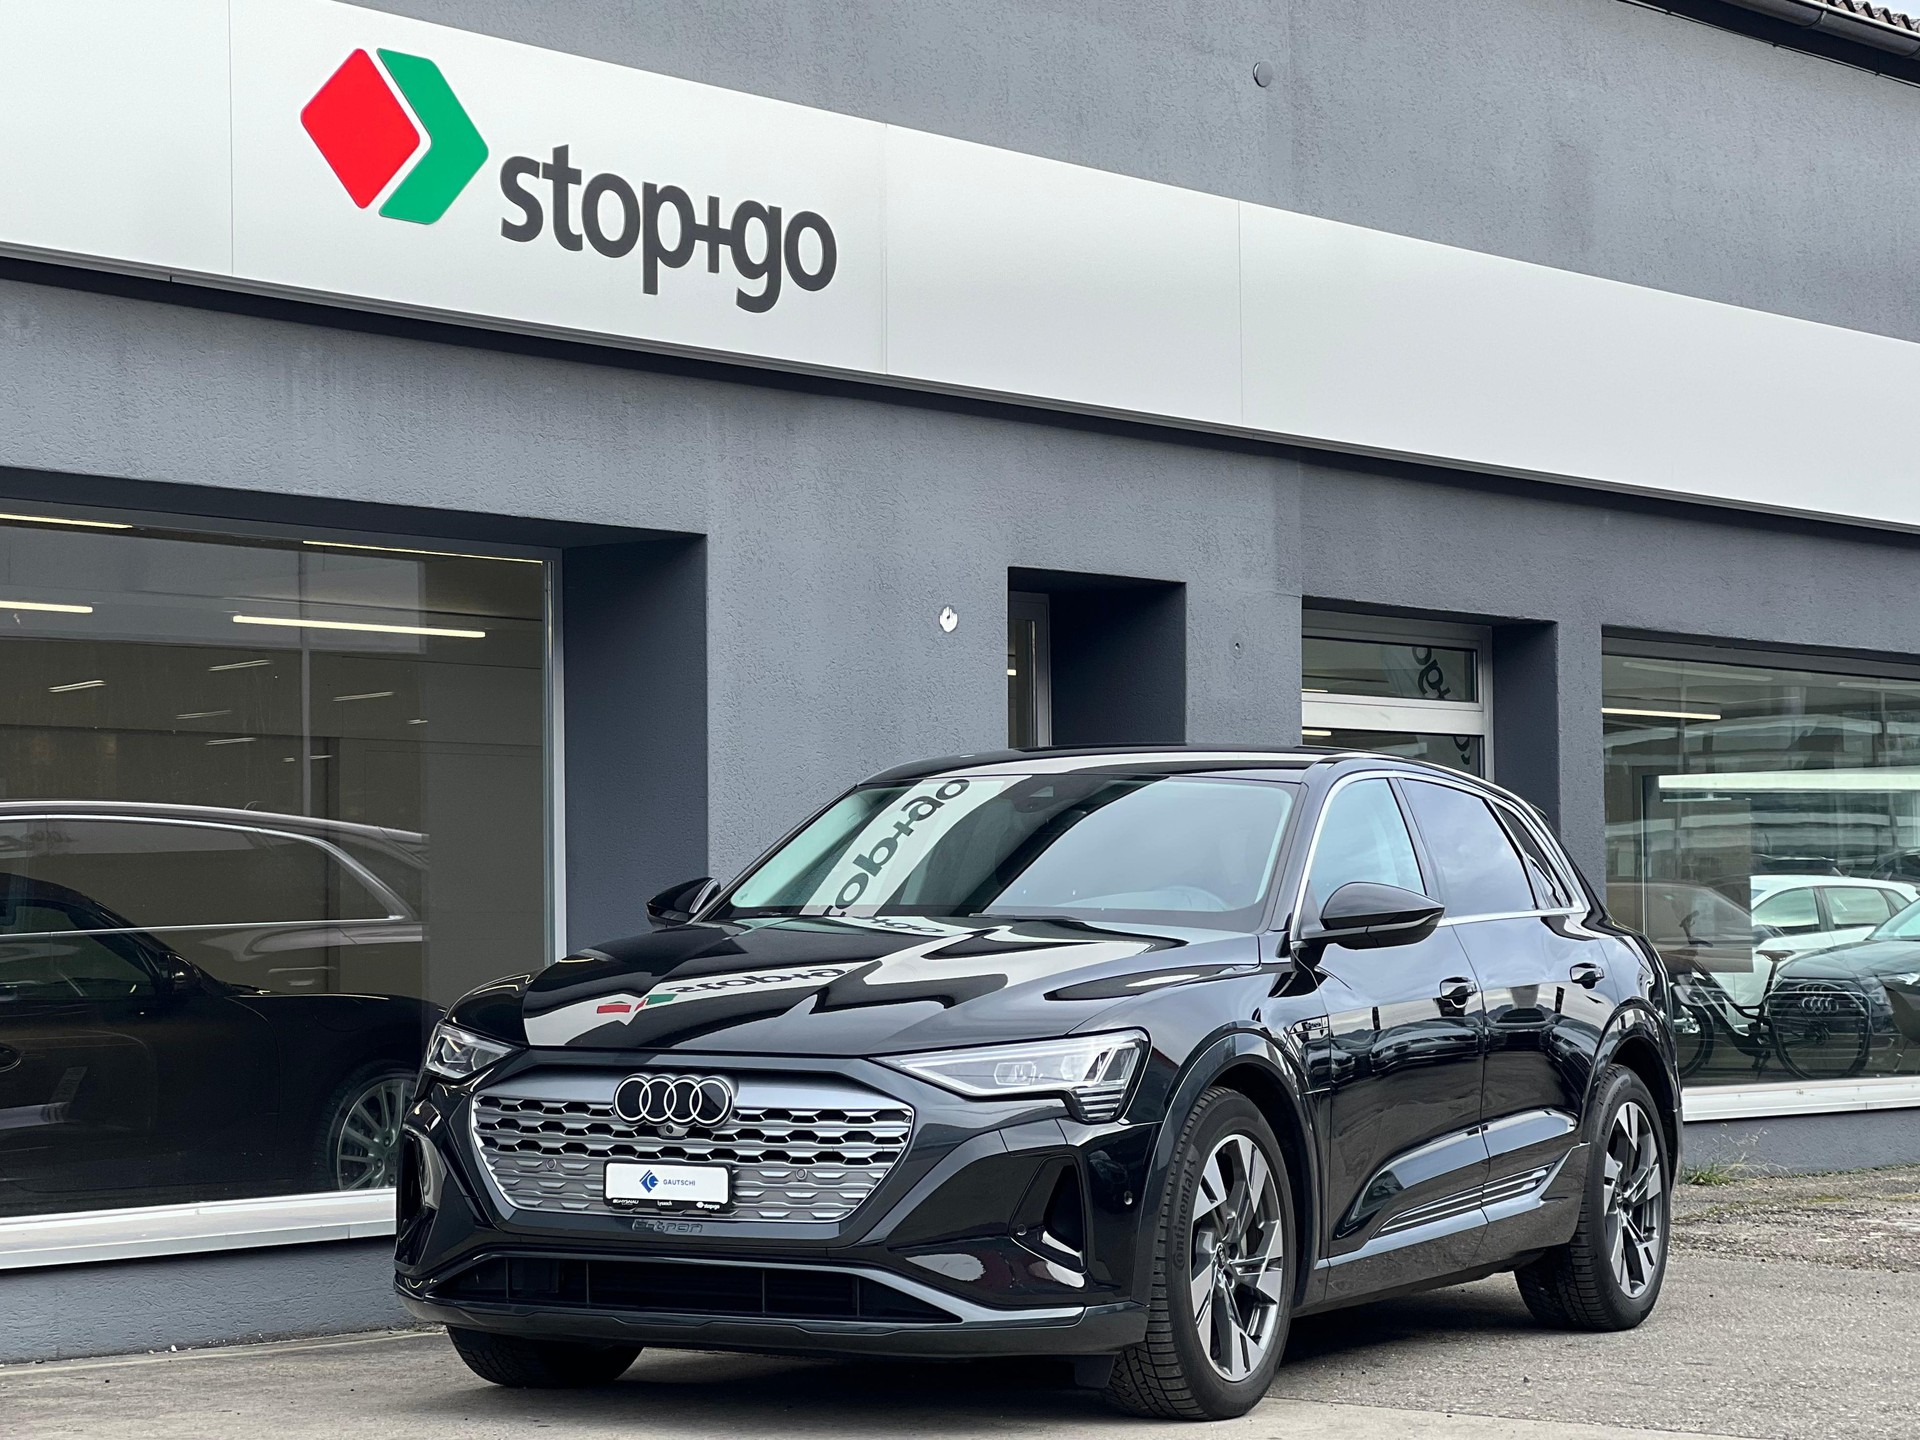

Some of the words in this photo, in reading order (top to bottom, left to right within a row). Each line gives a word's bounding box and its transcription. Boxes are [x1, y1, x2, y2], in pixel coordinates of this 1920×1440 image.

[500, 144, 838, 313] stop+go
[663, 1178, 696, 1186] GAUTSCHI
[1172, 1168, 1194, 1271] Continental
